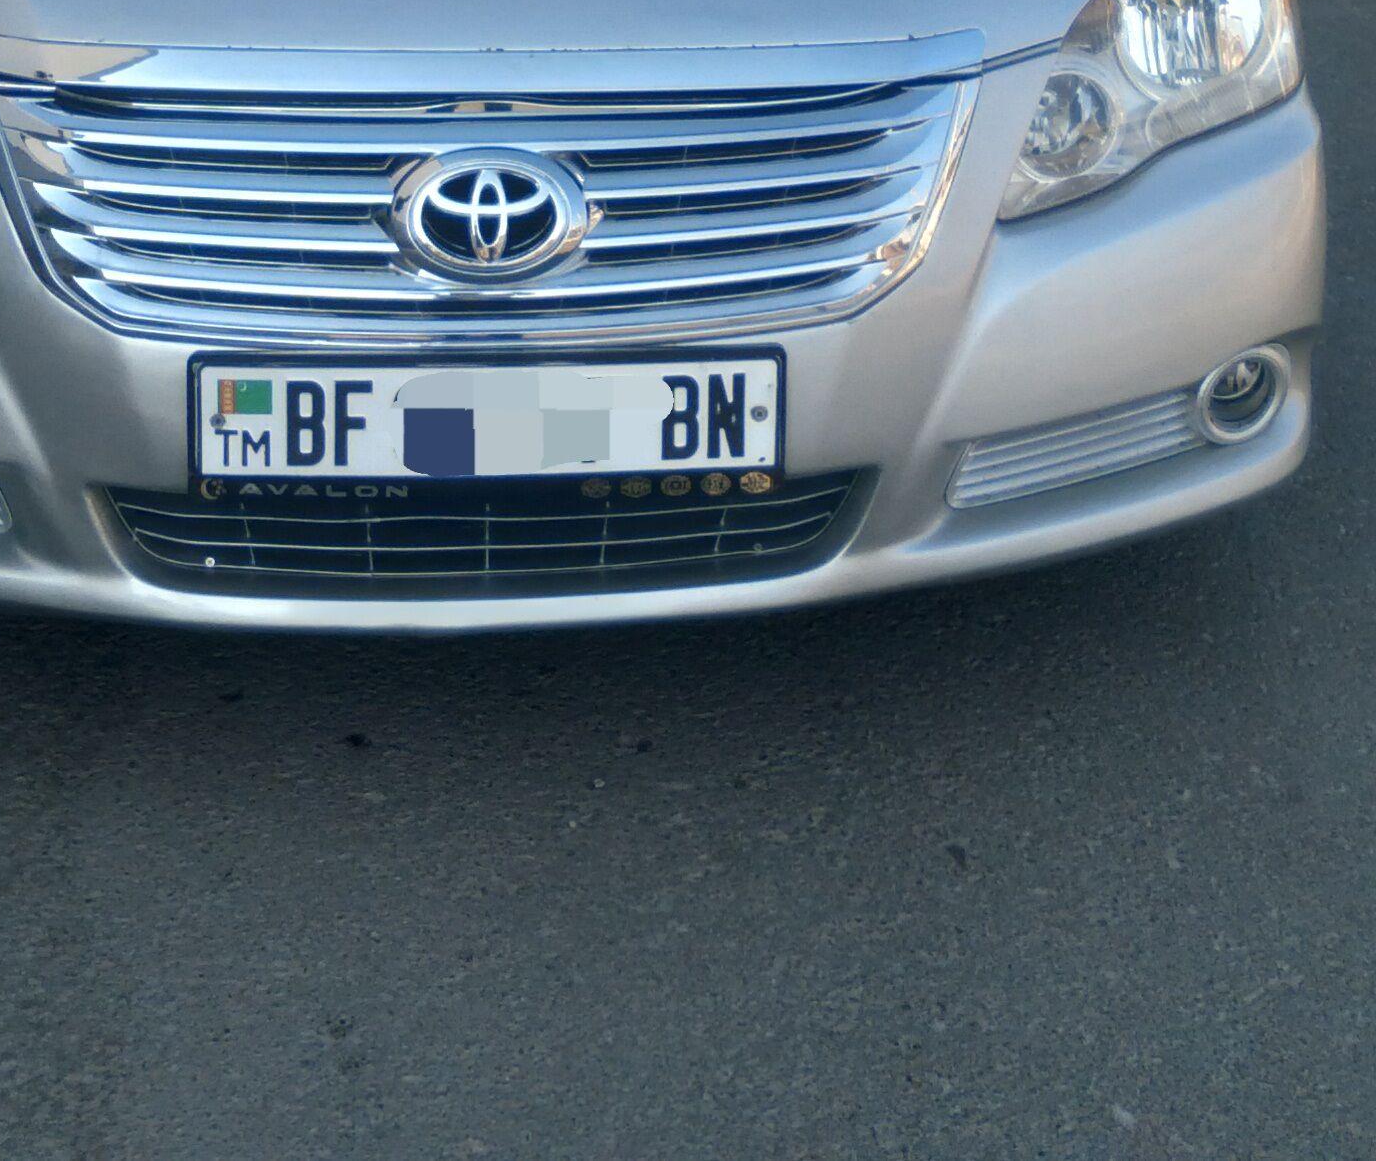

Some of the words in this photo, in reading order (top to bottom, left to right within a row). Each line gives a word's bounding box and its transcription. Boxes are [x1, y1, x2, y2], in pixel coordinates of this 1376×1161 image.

[285, 378, 374, 468] BF
[661, 372, 747, 461] BN
[214, 428, 270, 468] TM
[238, 480, 410, 499] AVALON
